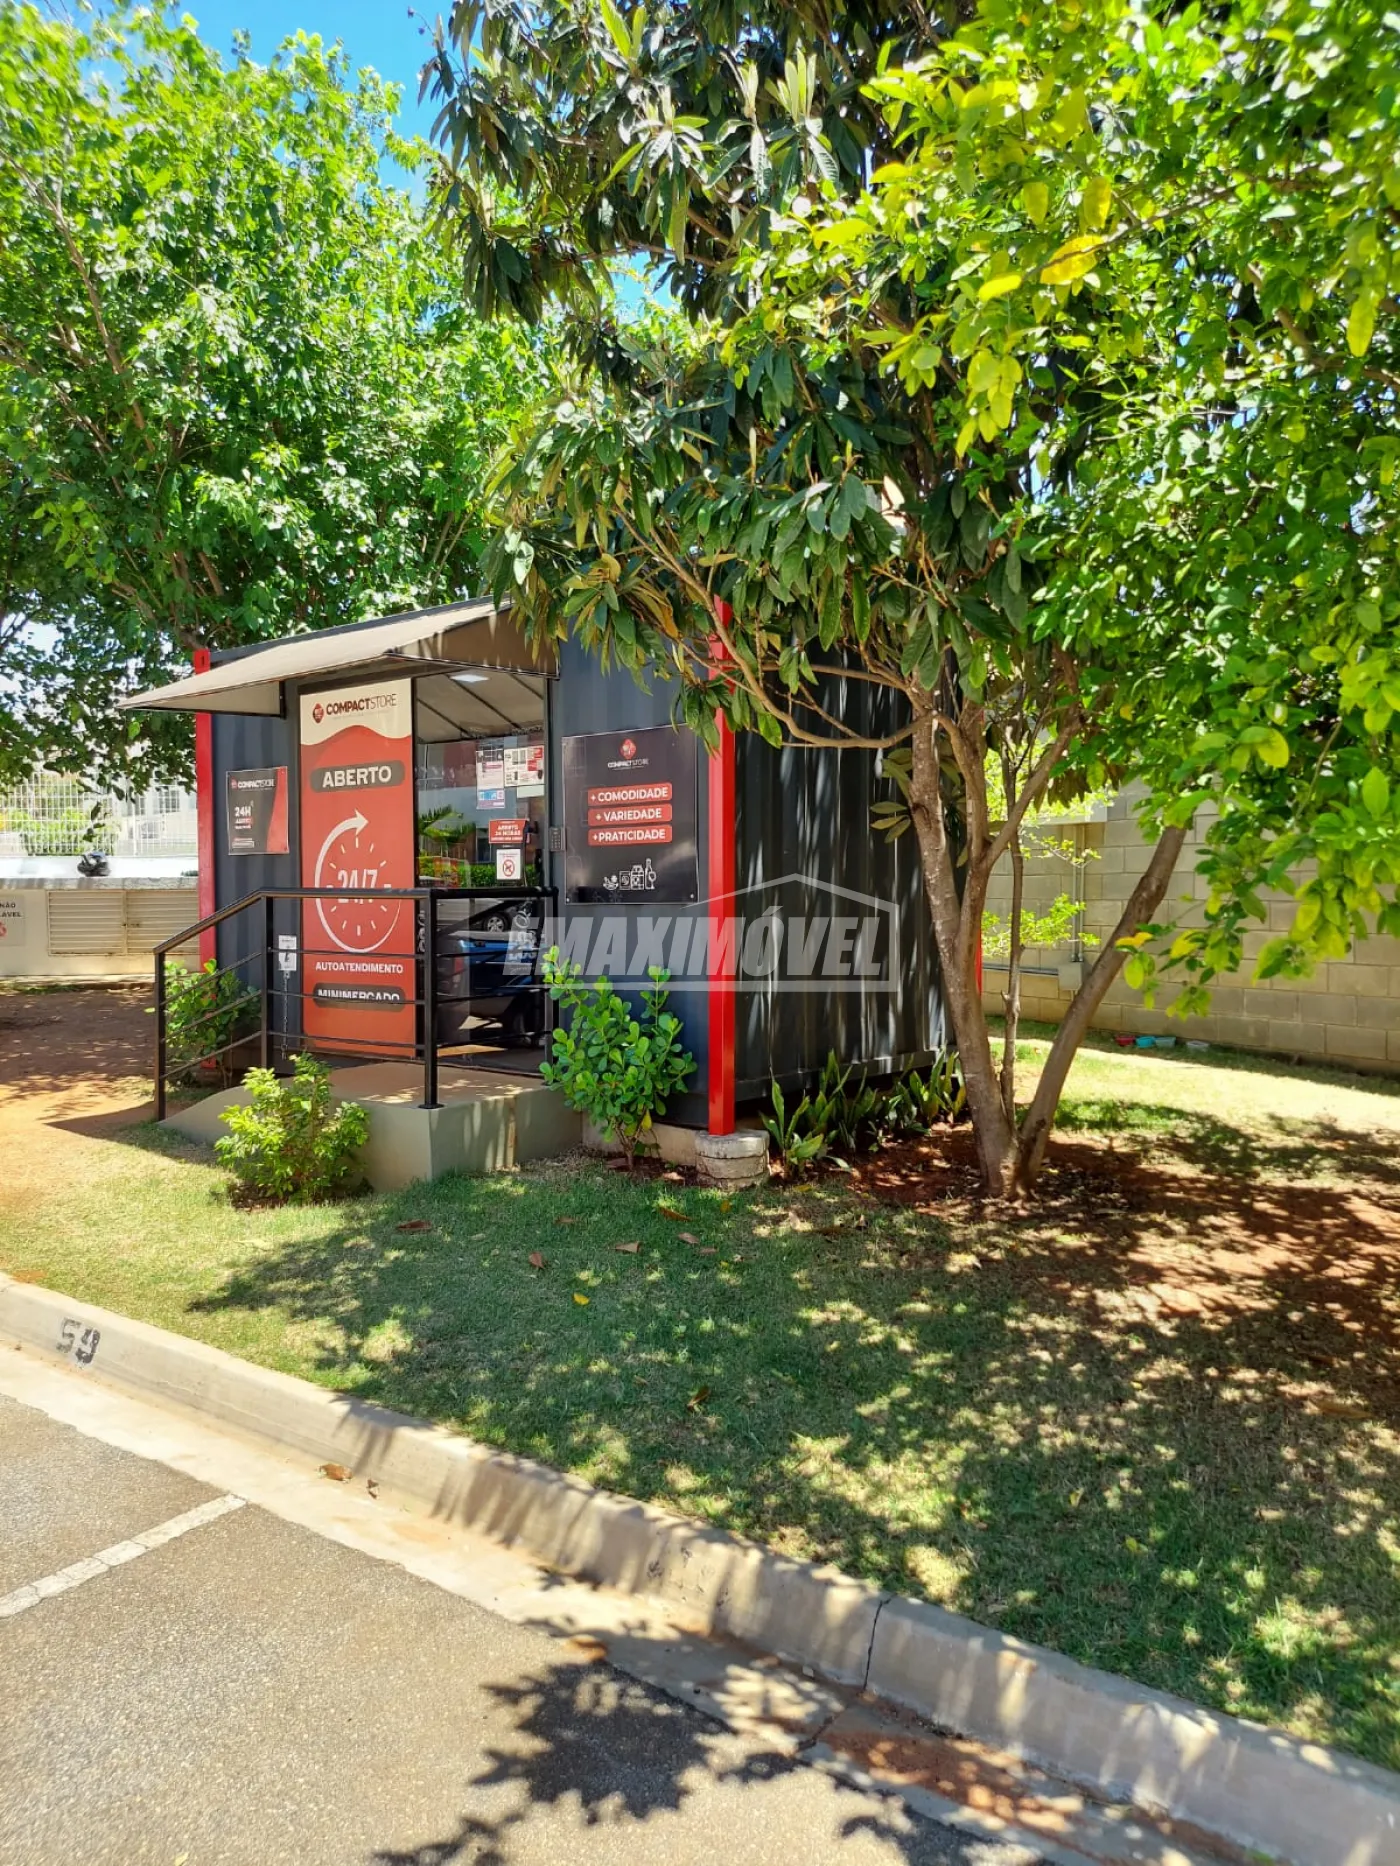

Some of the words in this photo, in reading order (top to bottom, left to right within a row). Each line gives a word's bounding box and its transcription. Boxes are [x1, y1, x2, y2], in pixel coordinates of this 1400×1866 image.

[326, 694, 398, 715] COMPACTSTORE
[322, 765, 392, 788] ABERTO
[597, 786, 669, 802] COMODIDADE
[234, 806, 252, 817] 24H
[603, 807, 663, 822] VARIEDADE
[338, 868, 378, 905] 24/7
[315, 961, 404, 974] AUTOATENDIMENTO
[56, 1316, 101, 1364] 59
